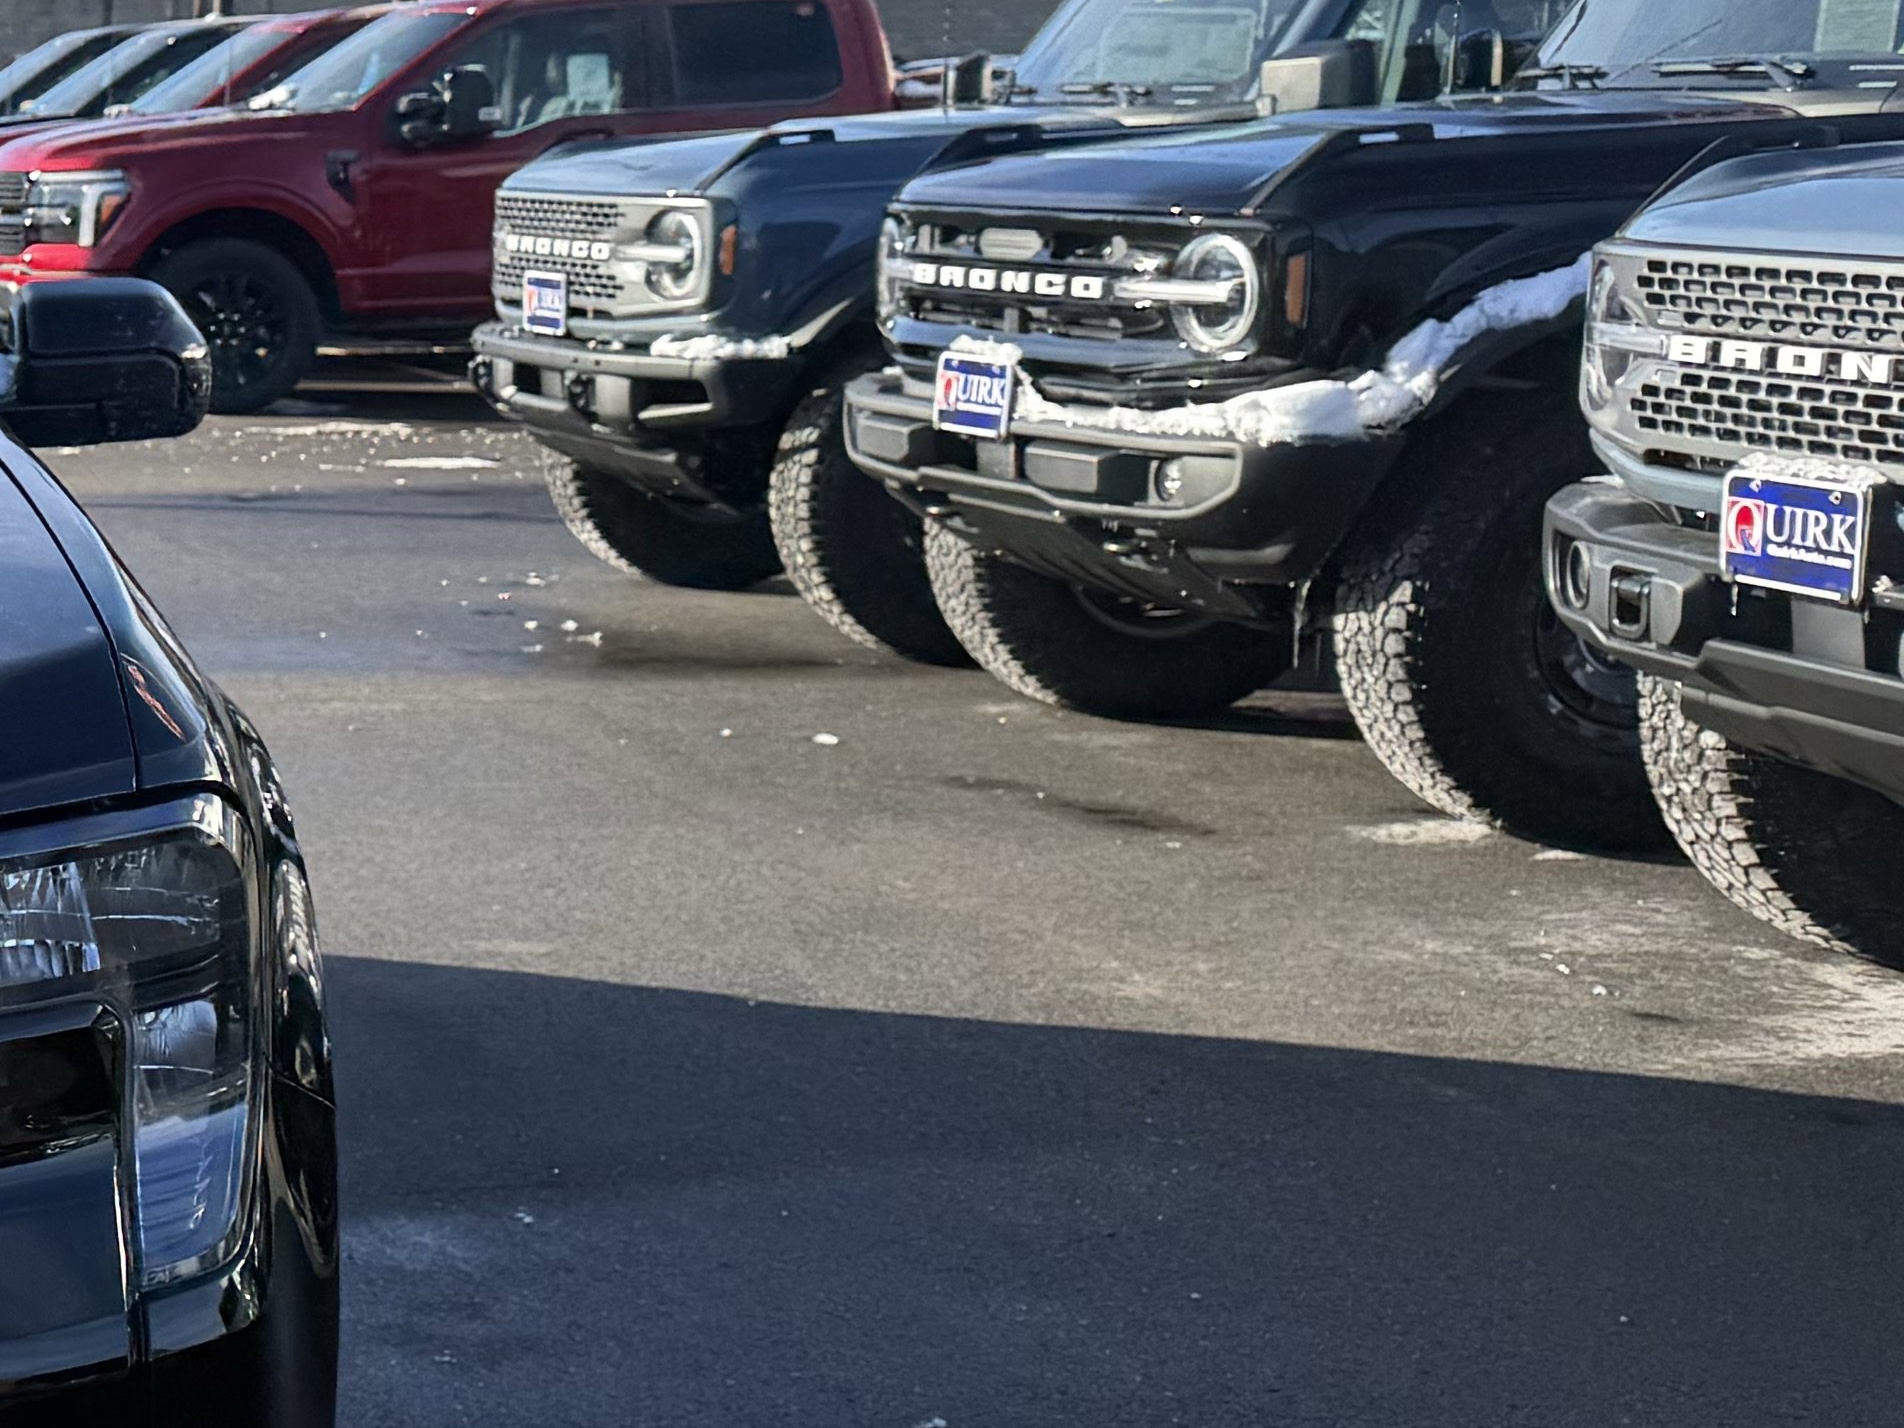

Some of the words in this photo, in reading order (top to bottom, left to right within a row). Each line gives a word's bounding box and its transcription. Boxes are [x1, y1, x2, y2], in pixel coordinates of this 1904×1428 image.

[505, 234, 610, 261] BRONCO
[912, 263, 1103, 299] BRONCO
[1668, 334, 1890, 384] BRON
[1727, 500, 1856, 556] QUIRK
